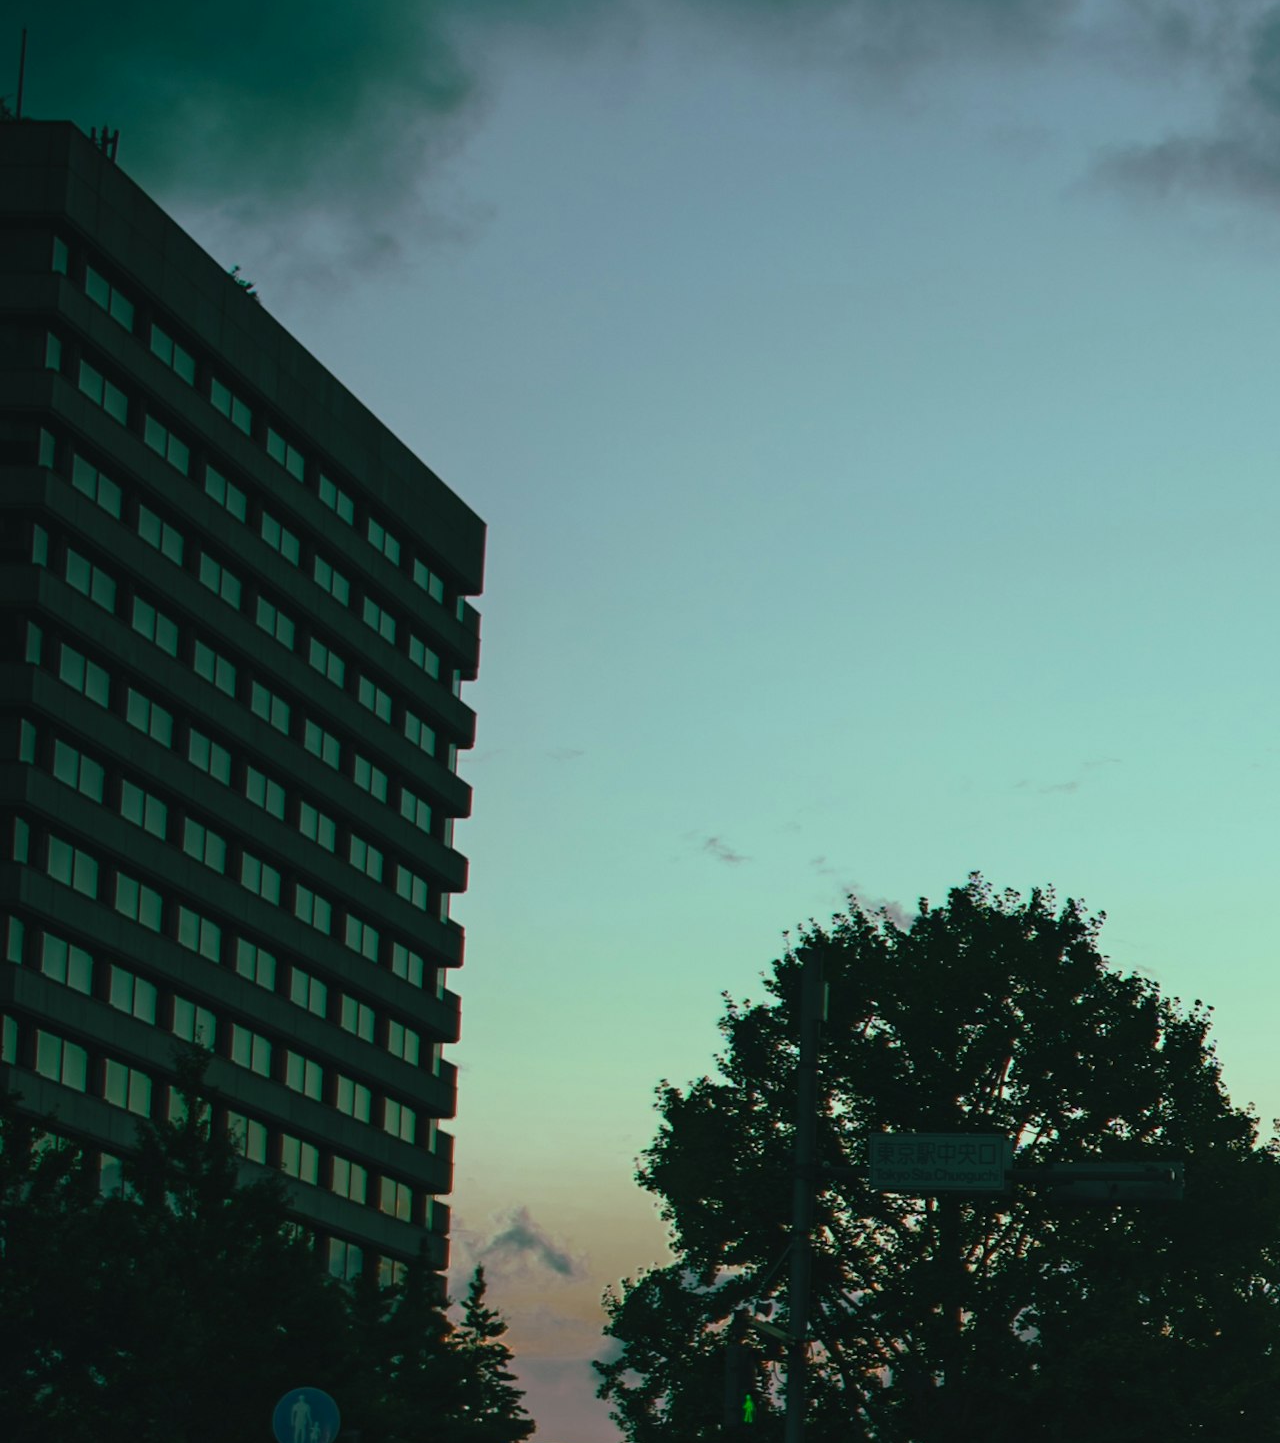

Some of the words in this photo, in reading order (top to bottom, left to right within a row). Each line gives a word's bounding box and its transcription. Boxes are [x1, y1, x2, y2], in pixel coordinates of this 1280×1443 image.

[877, 1142, 996, 1165] 東京駅中央口
[875, 1168, 911, 1183] Tokyo
[934, 1168, 999, 1183] Chuoguchi
